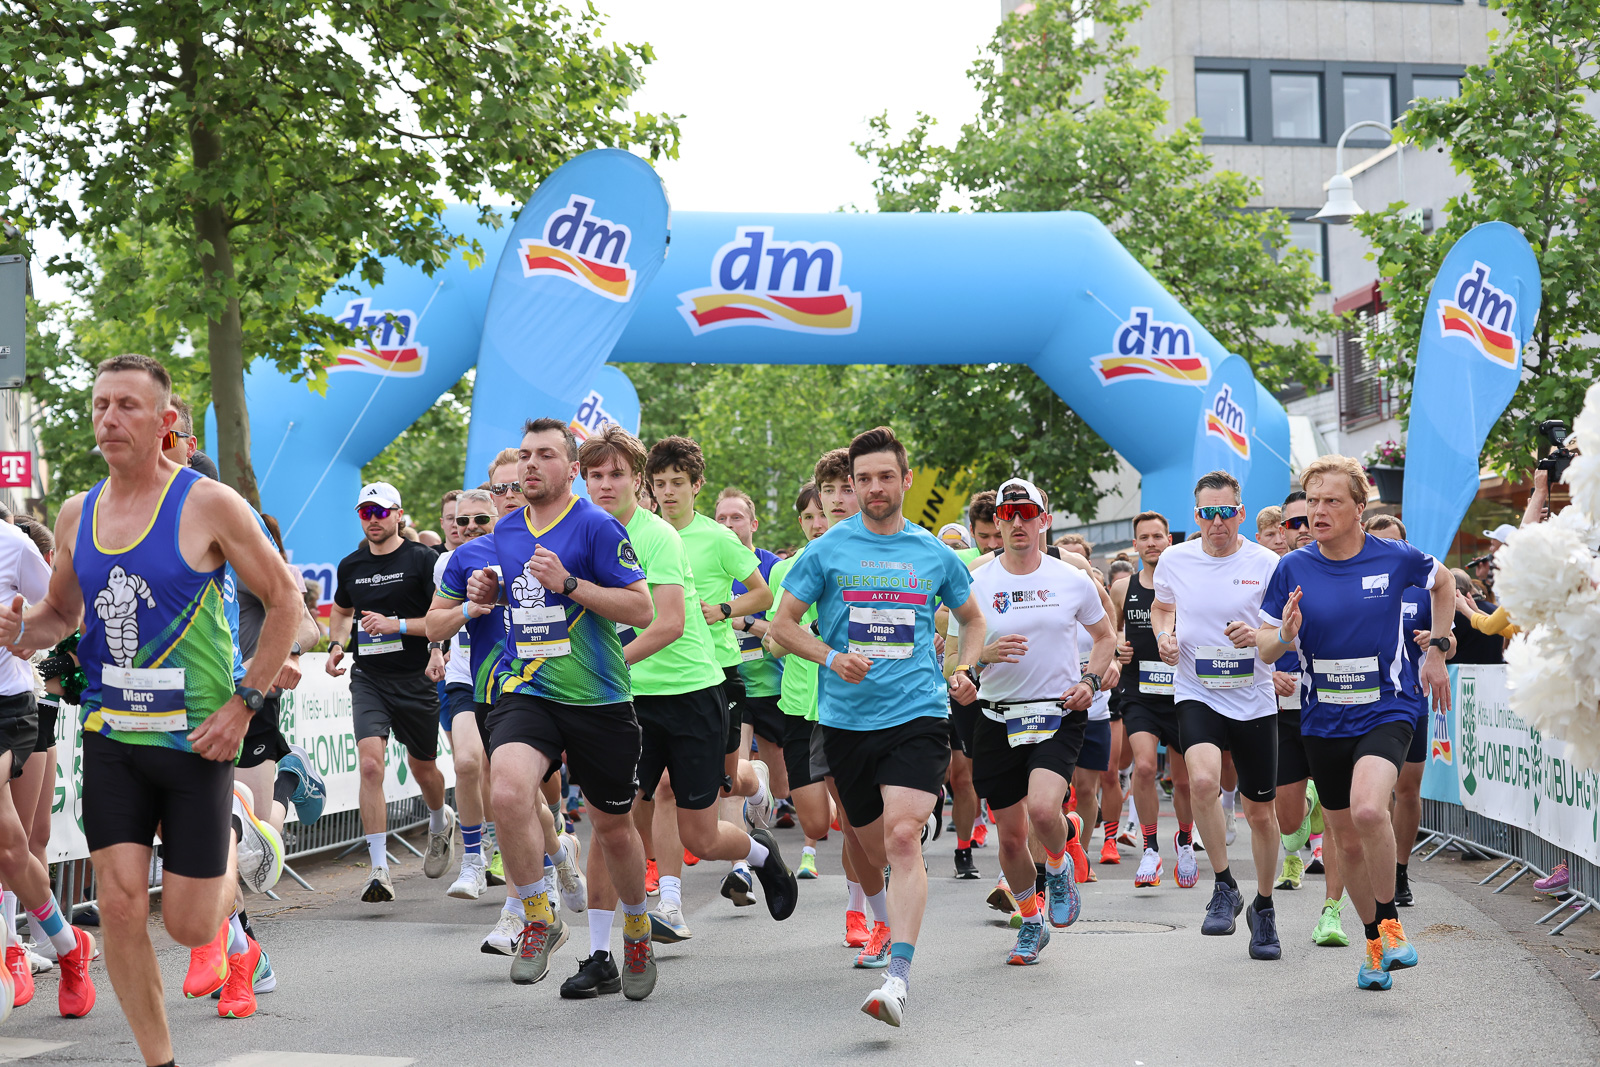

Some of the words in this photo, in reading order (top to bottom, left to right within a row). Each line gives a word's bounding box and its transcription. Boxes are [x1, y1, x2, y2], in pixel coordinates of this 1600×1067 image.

[548, 201, 626, 265] dm
[719, 231, 834, 292] dm
[1458, 267, 1513, 333] dm
[1118, 312, 1190, 356] dm
[1215, 388, 1243, 434] dm
[871, 593, 900, 601] AKTIV
[521, 624, 550, 635] Jeremy
[866, 624, 895, 634] Jonas
[1212, 660, 1239, 669] Stefan
[1148, 672, 1171, 683] 4650
[1326, 674, 1366, 683] Matthias
[122, 689, 154, 703] Marc
[130, 704, 148, 712] 3253
[332, 692, 352, 718] Unive
[1021, 714, 1046, 726] Martin
[1478, 741, 1530, 790] HOMBURG
